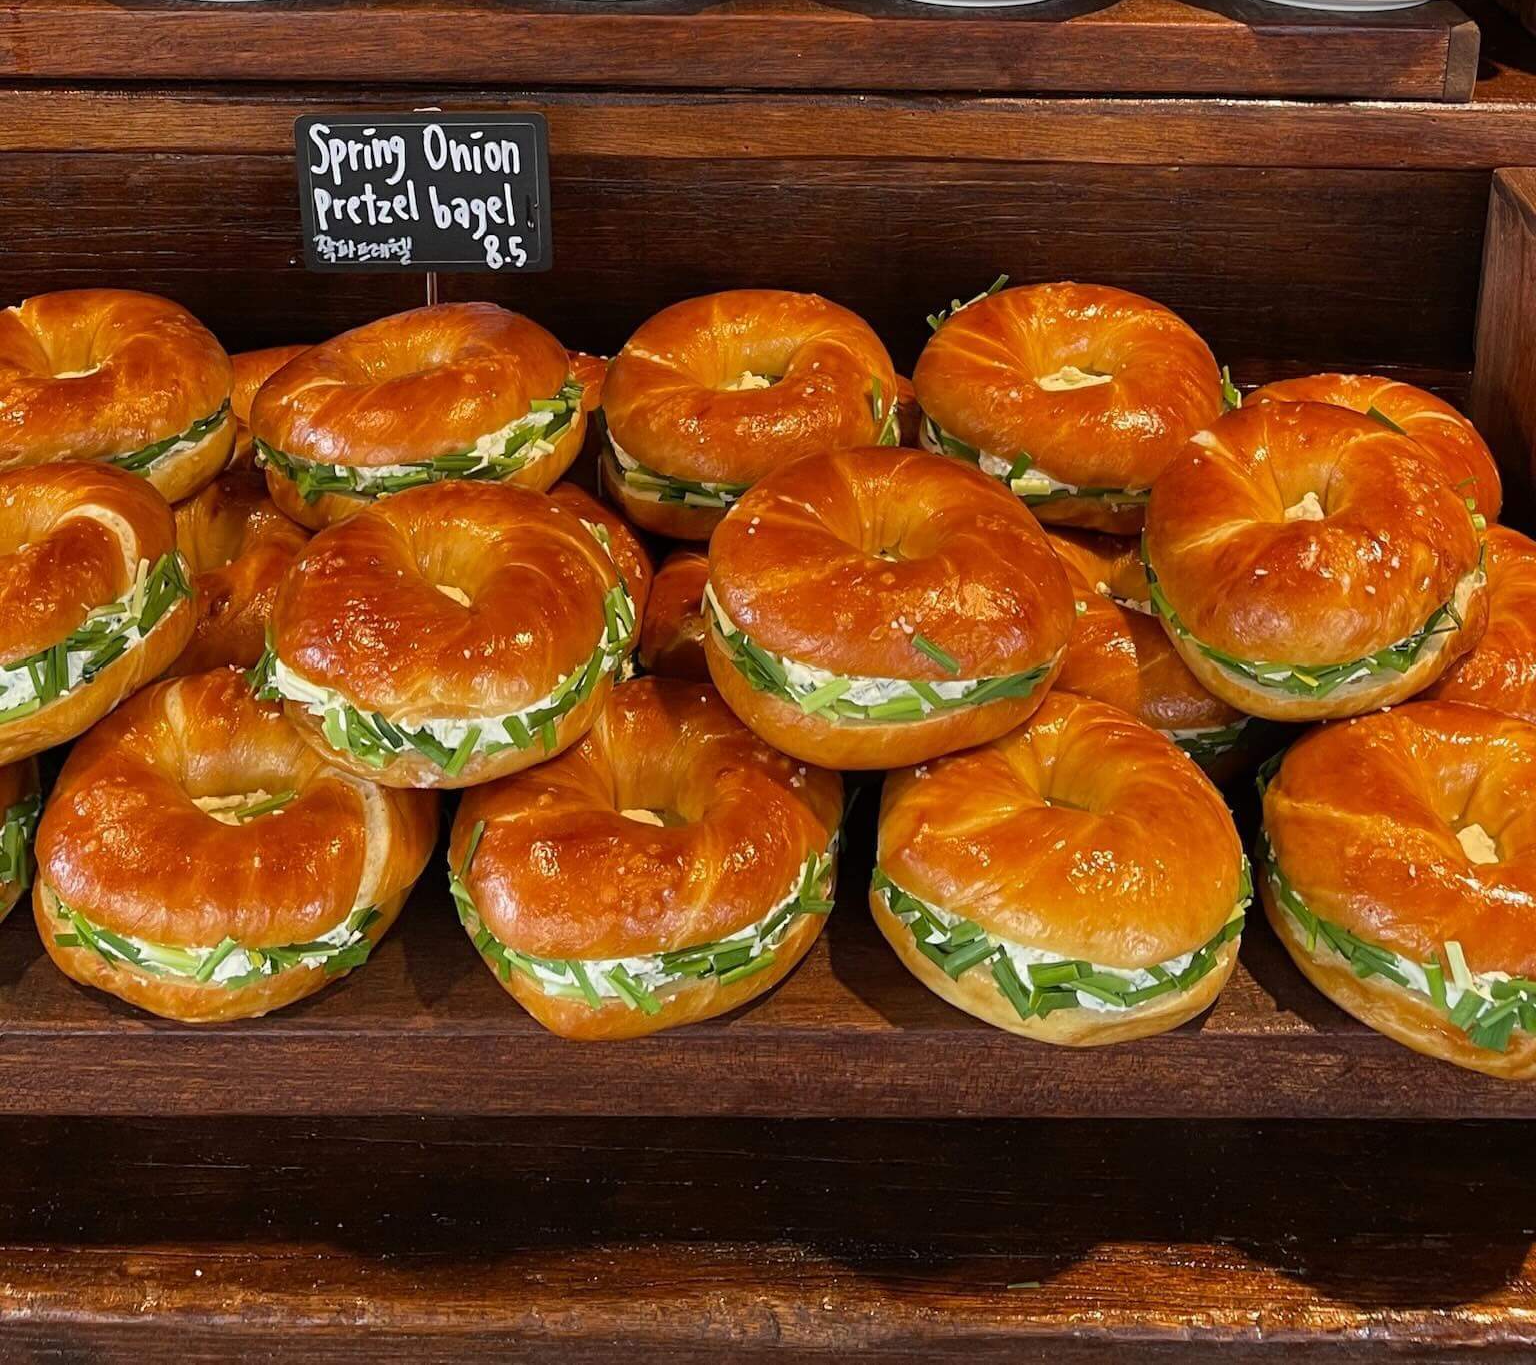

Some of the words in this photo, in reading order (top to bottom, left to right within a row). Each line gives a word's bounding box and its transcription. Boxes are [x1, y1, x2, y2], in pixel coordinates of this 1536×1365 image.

[308, 122, 406, 185] Spring
[423, 123, 521, 175] Onion
[429, 182, 515, 239] bagel
[483, 235, 528, 270] 8.5
